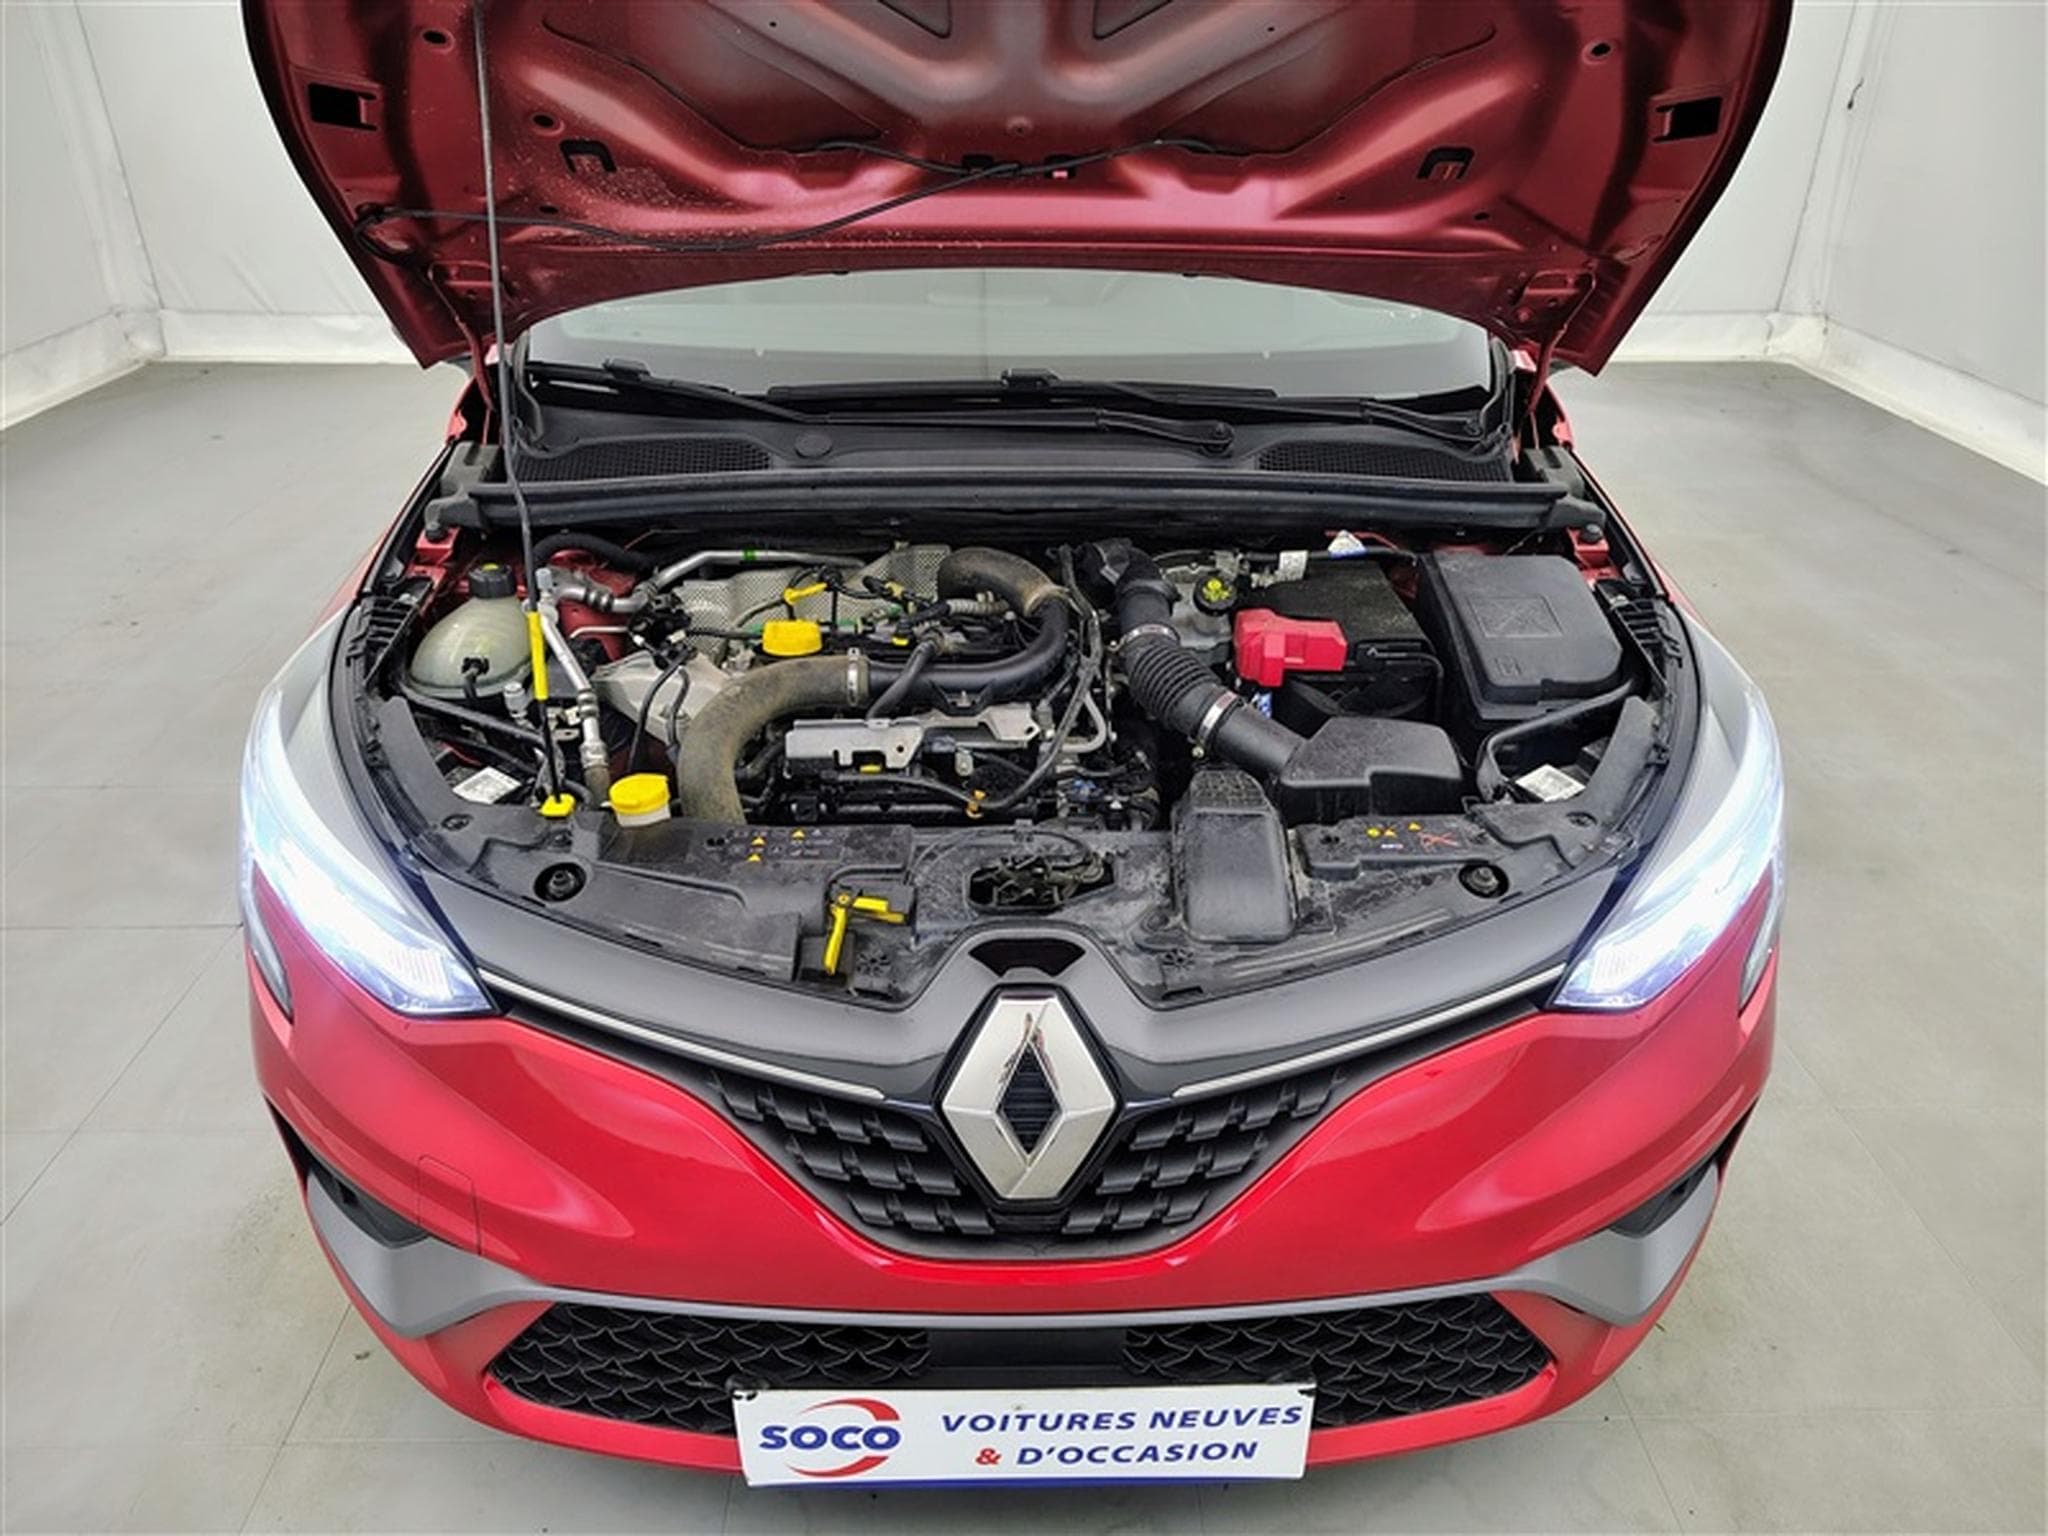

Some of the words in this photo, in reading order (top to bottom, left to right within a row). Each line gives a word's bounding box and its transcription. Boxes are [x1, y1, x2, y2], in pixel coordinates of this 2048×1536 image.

[942, 1412, 1136, 1433] VOITURES
[1150, 1406, 1303, 1430] NEUVES
[759, 1424, 902, 1452] SOCO
[975, 1448, 1002, 1466] &
[1016, 1441, 1259, 1466] D'OCCASION
